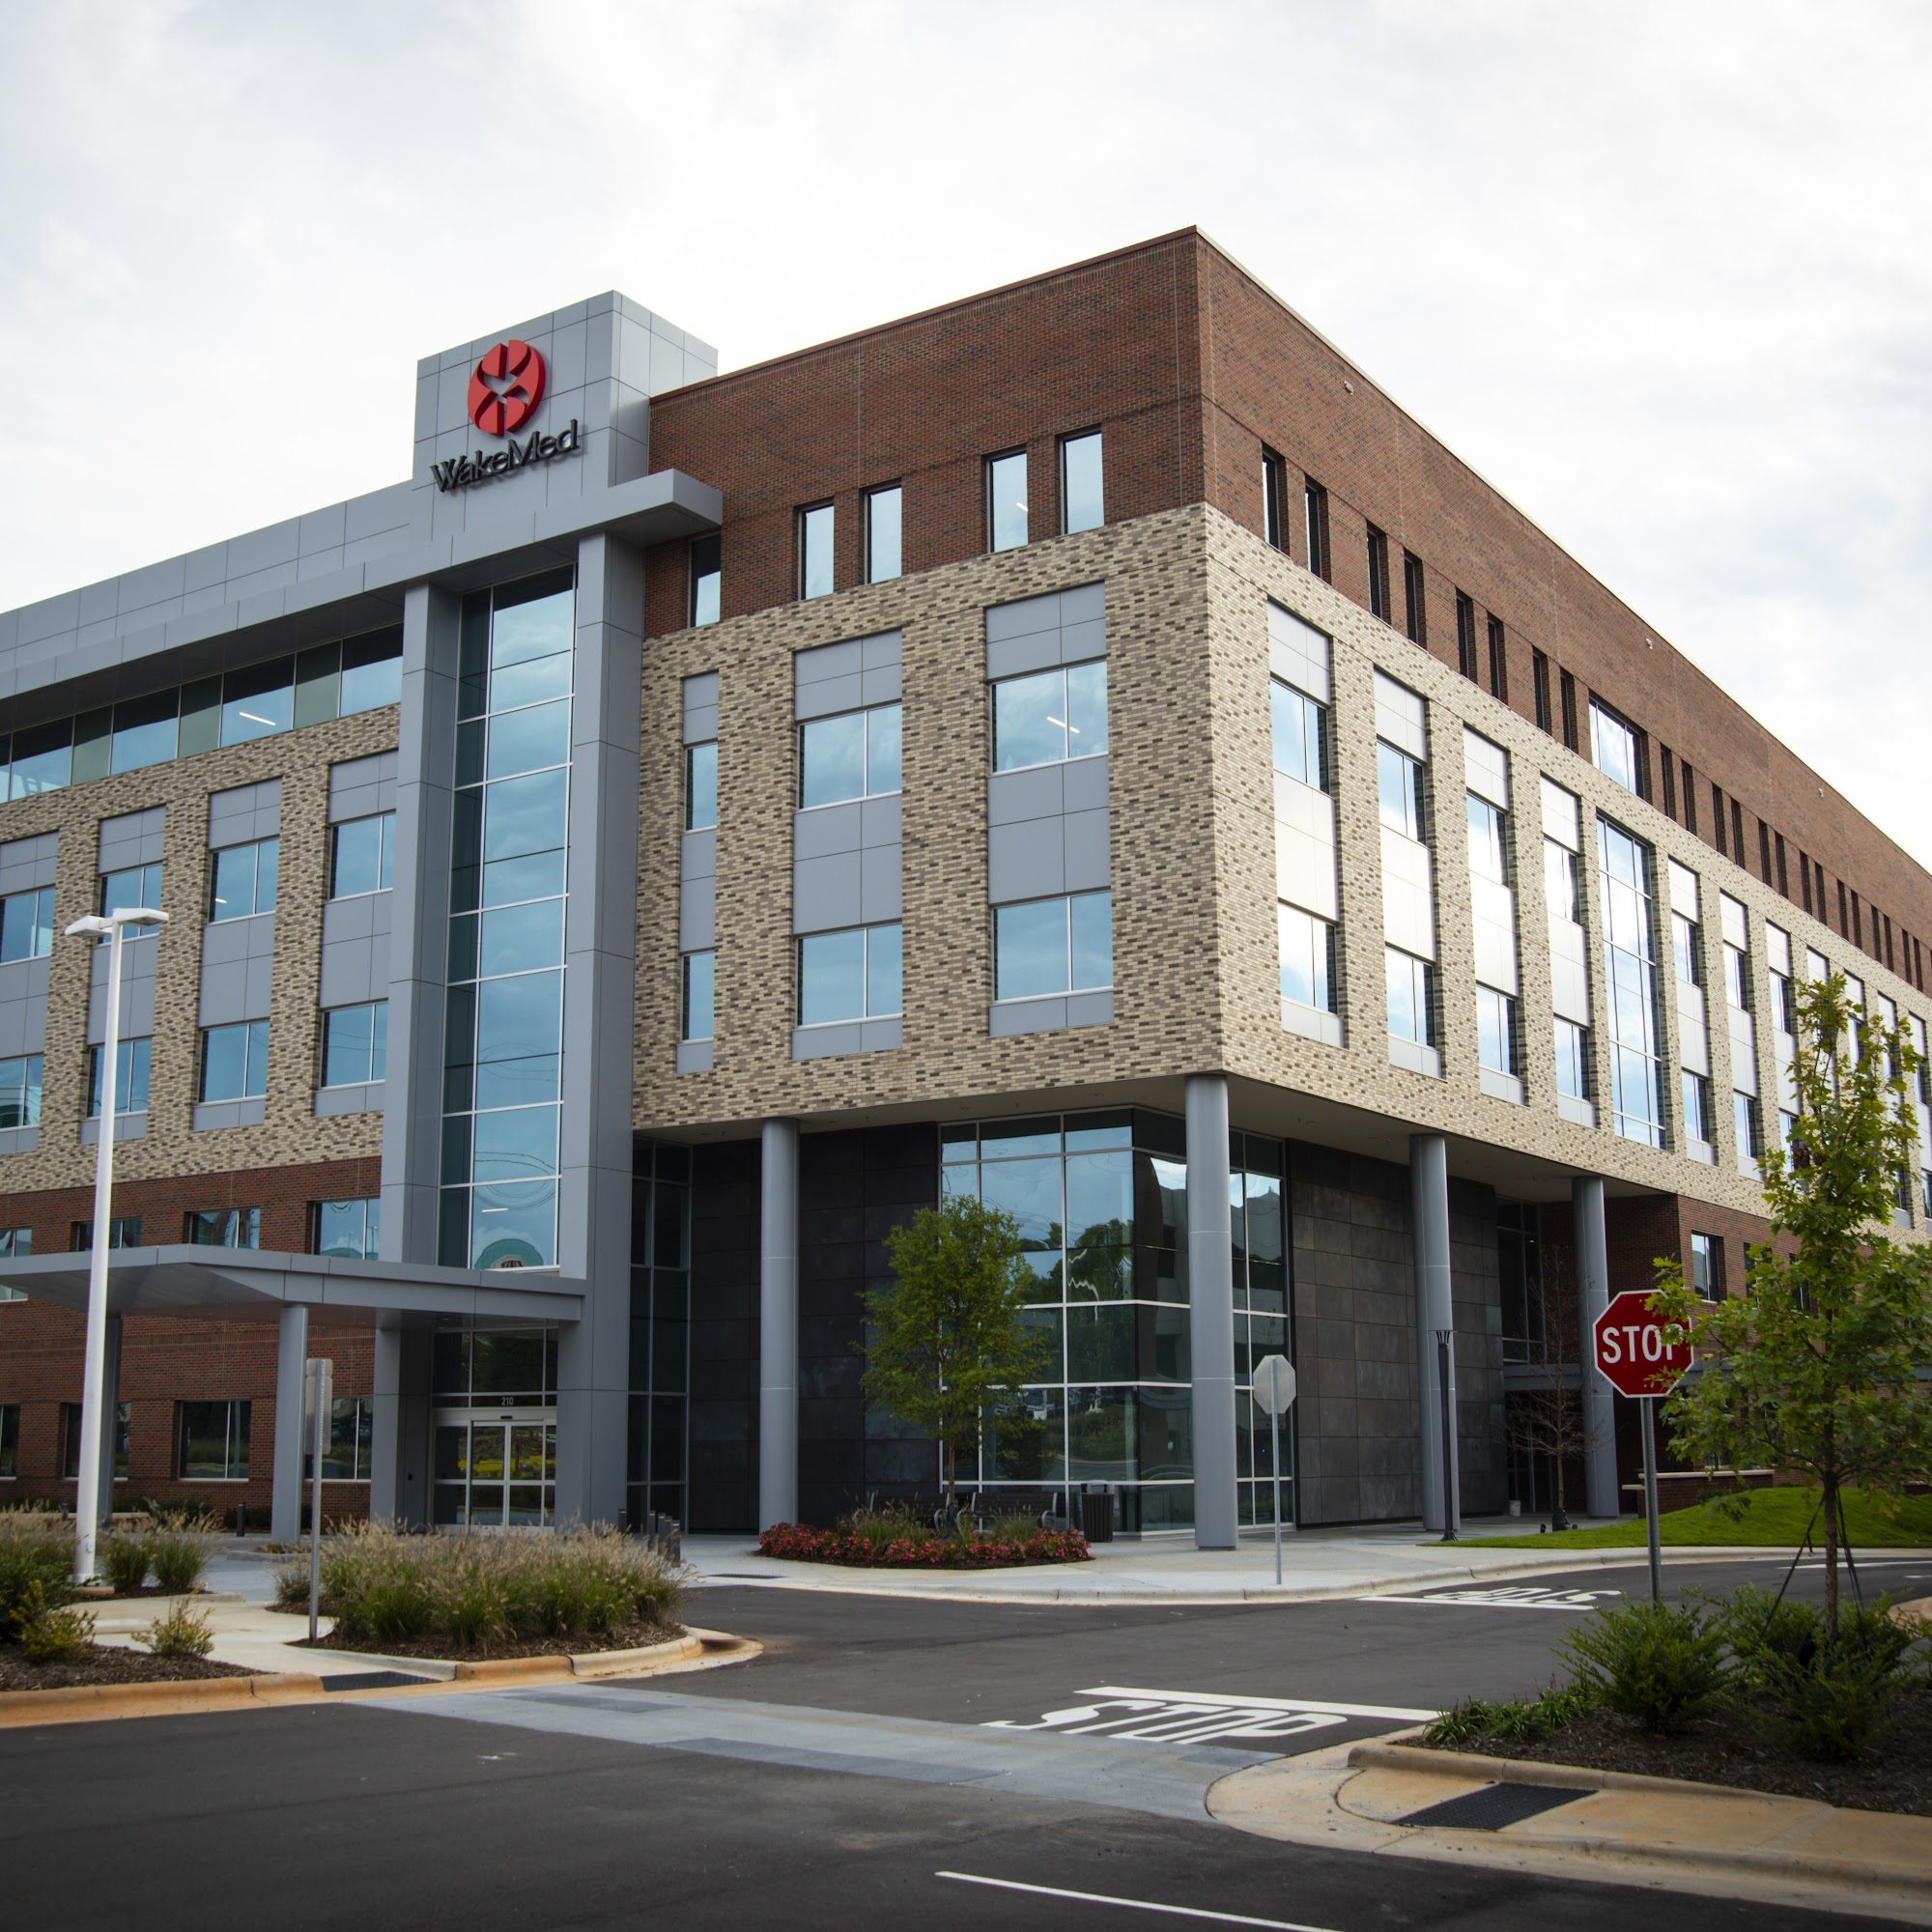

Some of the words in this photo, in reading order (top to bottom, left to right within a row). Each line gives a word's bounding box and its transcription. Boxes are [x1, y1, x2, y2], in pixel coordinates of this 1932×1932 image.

[430, 418, 580, 493] WakeMed
[501, 1397, 514, 1406] 210
[978, 1699, 1349, 1745] STOP
